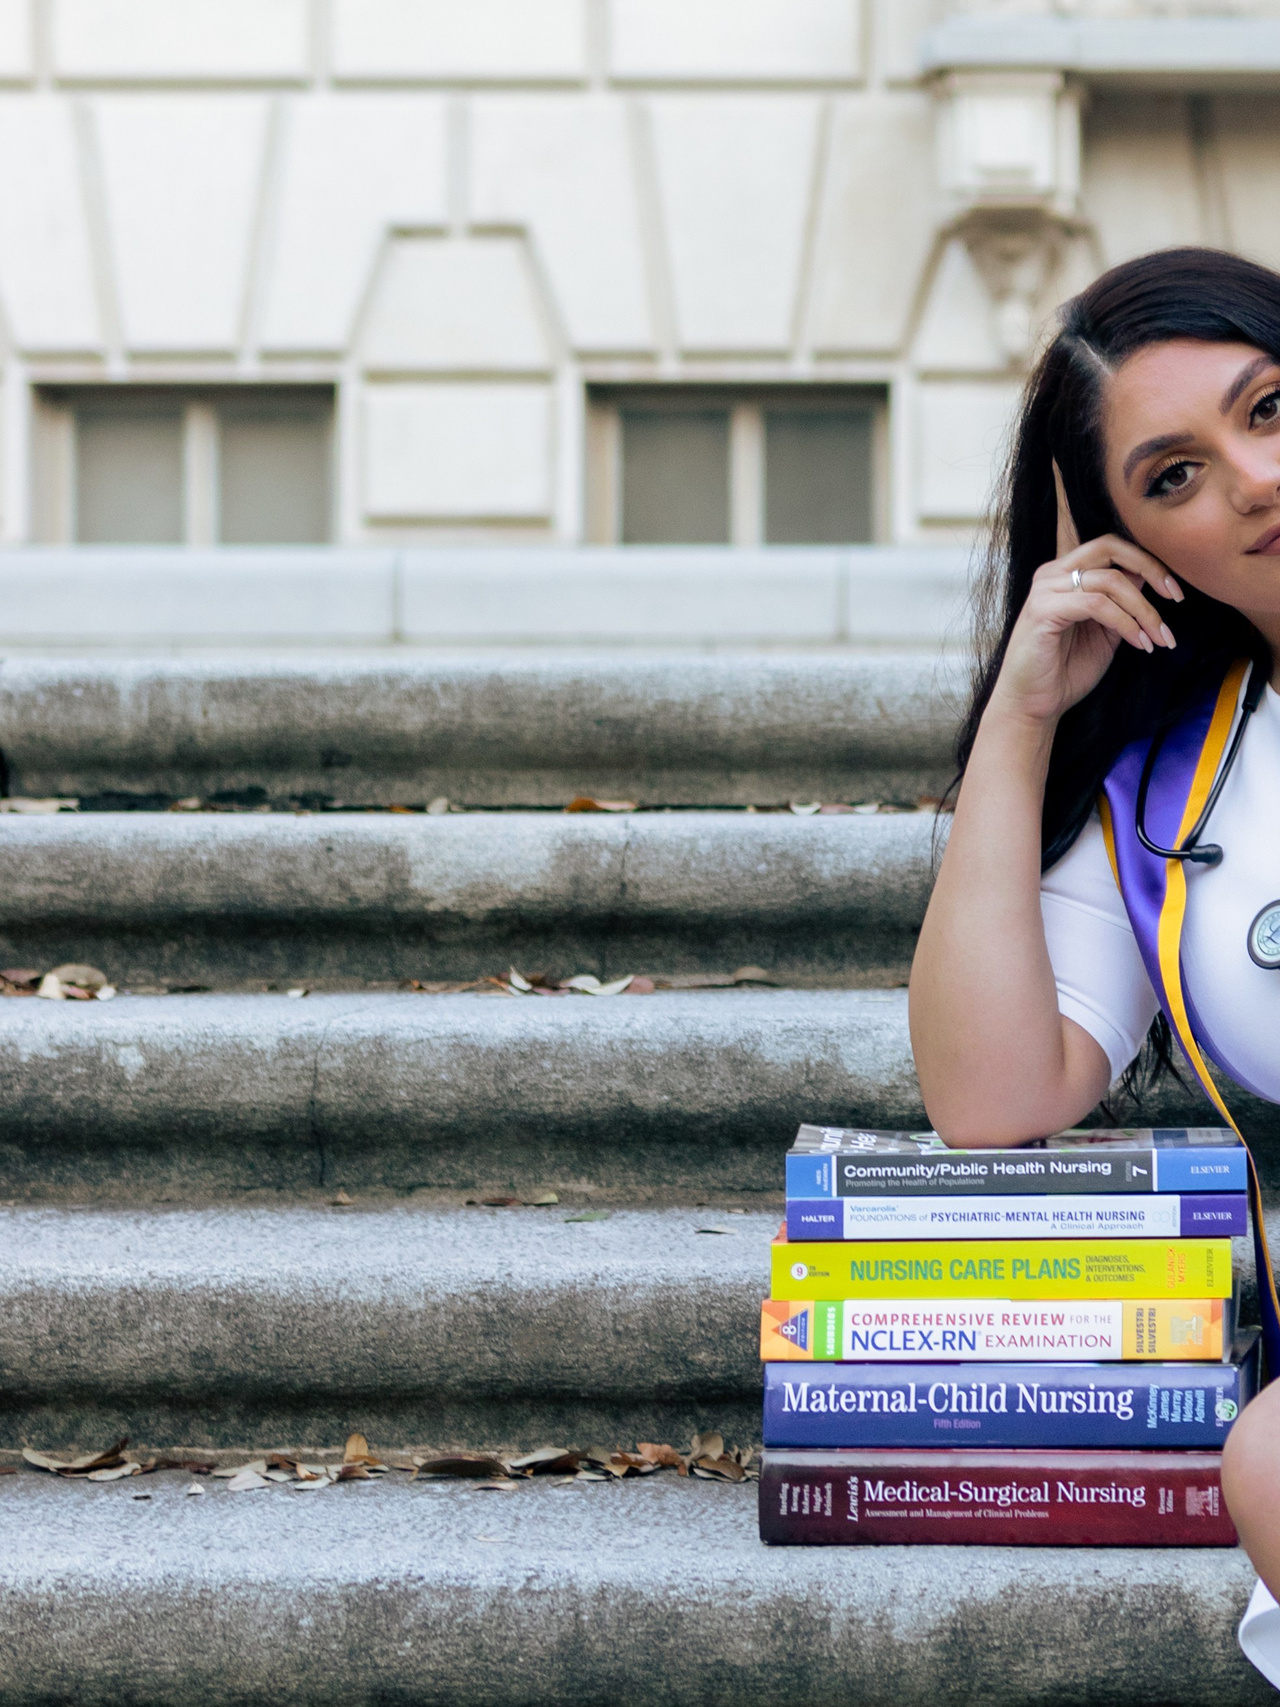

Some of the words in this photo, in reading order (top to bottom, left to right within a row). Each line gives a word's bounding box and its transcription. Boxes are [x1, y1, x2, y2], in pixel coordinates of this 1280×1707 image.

[844, 1163, 988, 1179] Community/Public
[993, 1161, 1045, 1176] Health
[1050, 1160, 1112, 1175] Nursing
[1132, 1165, 1148, 1177] 7
[1190, 1166, 1230, 1175] ELSEVIER
[845, 1179, 886, 1189] Promoting
[888, 1179, 900, 1187] the
[902, 1178, 926, 1187] Health
[928, 1178, 937, 1186] of
[939, 1177, 985, 1187] Populations
[801, 1215, 835, 1223] HALTER
[850, 1213, 917, 1223] FOUNDATIONS
[919, 1213, 929, 1221] of
[931, 1211, 1049, 1223] PSYCHIATRIC-MENTAL
[1052, 1211, 1093, 1222] HEALTH
[1096, 1210, 1145, 1221] NURSING
[1193, 1212, 1232, 1221] ELSEVIER
[1060, 1222, 1095, 1231] Clinical
[1098, 1222, 1144, 1232] Approach
[1086, 1255, 1130, 1264] DIAGNOSES,
[1086, 1264, 1146, 1273] INTERVENTIONS,
[1178, 1253, 1186, 1283] MYERS
[797, 1266, 803, 1276] 9
[850, 1260, 943, 1281] NURSING
[949, 1259, 1005, 1280] CARE
[1011, 1258, 1081, 1279] PLANS
[1086, 1274, 1091, 1282] &
[1094, 1274, 1135, 1282] OUTCOMES
[852, 1313, 995, 1326] COMPREHENSIVE
[1002, 1313, 1065, 1326] REVIEW
[1070, 1314, 1091, 1324] FOR
[1094, 1314, 1112, 1324] THE
[782, 1324, 797, 1335] 8
[826, 1306, 836, 1355] SAUNDERS
[1136, 1308, 1144, 1354] SILVESTRI
[1148, 1308, 1156, 1354] SILVESTRI
[986, 1335, 1112, 1348] EXAMINATION
[782, 1382, 1008, 1413] Maternal-Child
[1016, 1383, 1134, 1420] Nursing
[1147, 1384, 1159, 1429] McKinney
[1159, 1390, 1170, 1422] James
[1171, 1389, 1183, 1423] Murray
[1183, 1390, 1193, 1422] Nelson
[1194, 1389, 1205, 1423] Ashwill
[1215, 1387, 1223, 1427] ELIER
[933, 1419, 951, 1429] Fifth
[954, 1419, 981, 1429] Edition
[780, 1482, 789, 1515] Harding
[813, 1486, 822, 1513] Hagler
[847, 1476, 859, 1522] Lewis's
[864, 1480, 1049, 1507] Medical-Surgical
[1056, 1481, 1146, 1507] Nursing
[865, 1508, 907, 1518] Assessment
[909, 1508, 924, 1518] and
[926, 1508, 973, 1520] Management
[974, 1508, 983, 1518] of
[983, 1508, 1013, 1519] Clinical
[1014, 1508, 1049, 1518] Problems
